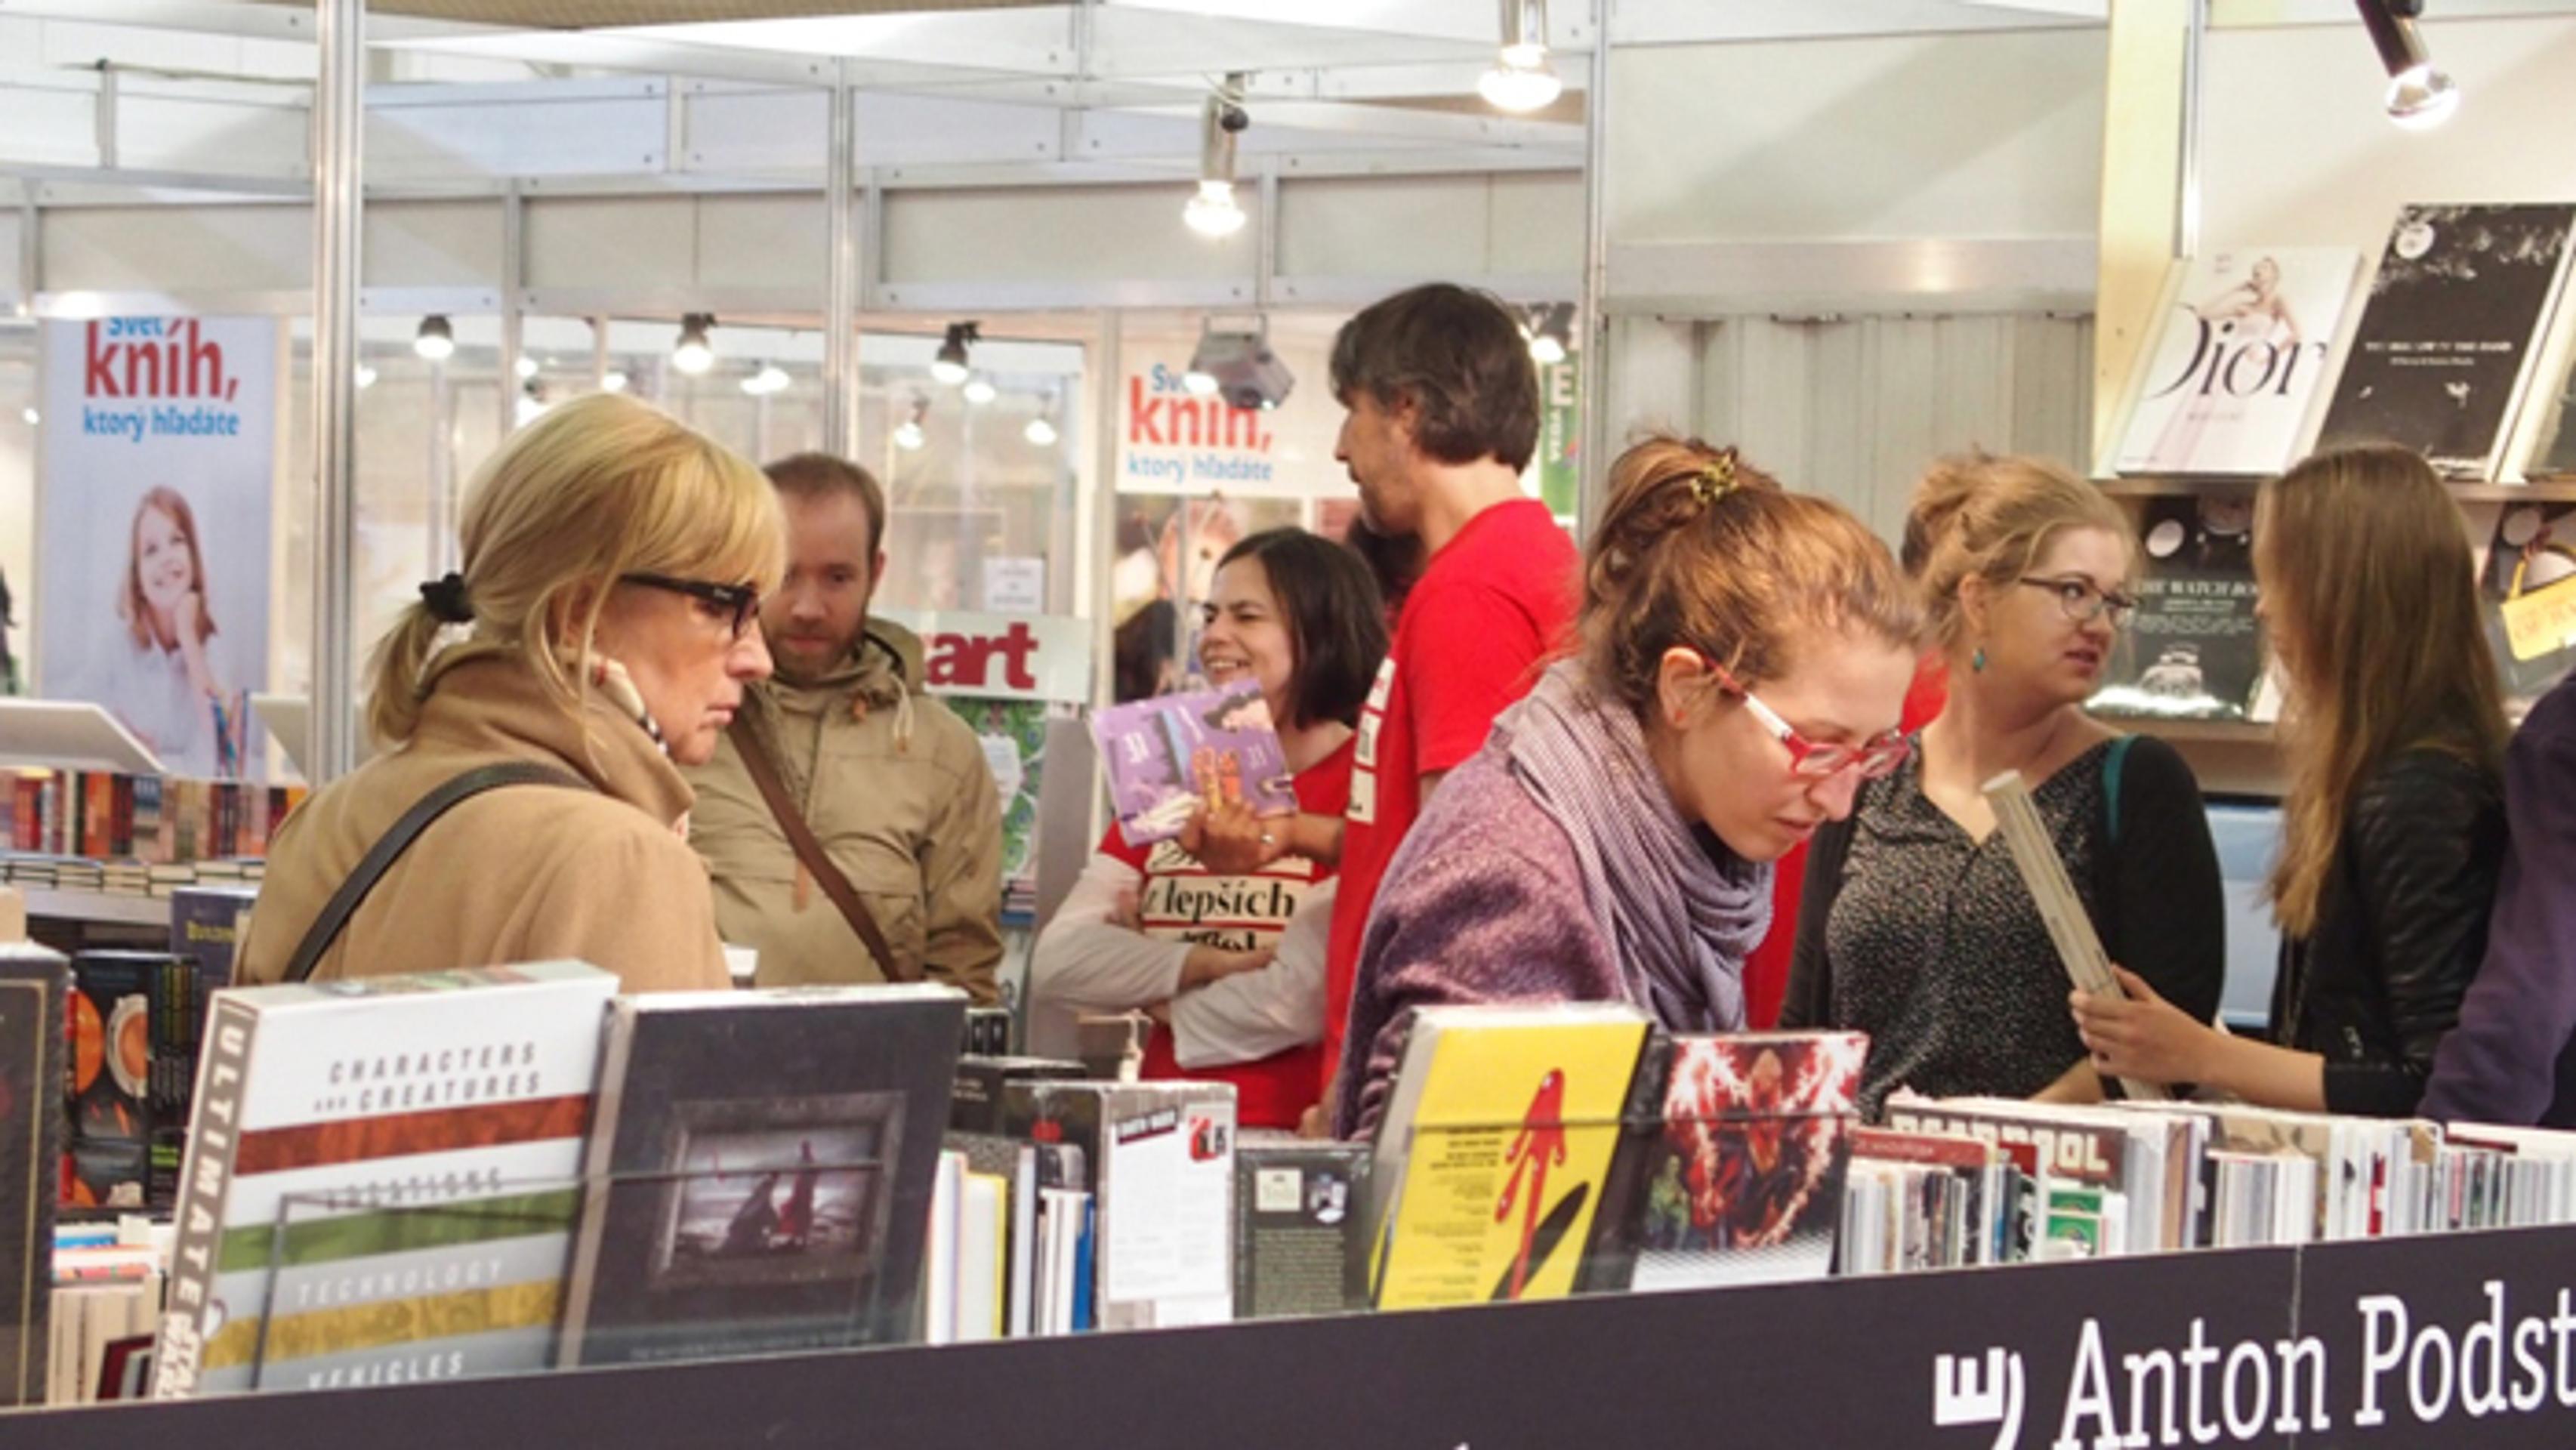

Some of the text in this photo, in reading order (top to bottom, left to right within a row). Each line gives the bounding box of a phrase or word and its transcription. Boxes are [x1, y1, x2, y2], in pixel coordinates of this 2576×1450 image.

[85, 318, 239, 403] kníh,
[2145, 301, 2328, 398] Dior
[1165, 880, 1295, 924] lepších
[329, 1041, 535, 1085] CHARACTERS
[359, 1070, 540, 1112] CREATURES
[174, 1024, 245, 1309] ULTIMATE
[298, 1259, 501, 1306] TECHNOLOGY
[308, 1350, 464, 1390] VEHICLES
[2053, 1317, 2331, 1449] Anton
